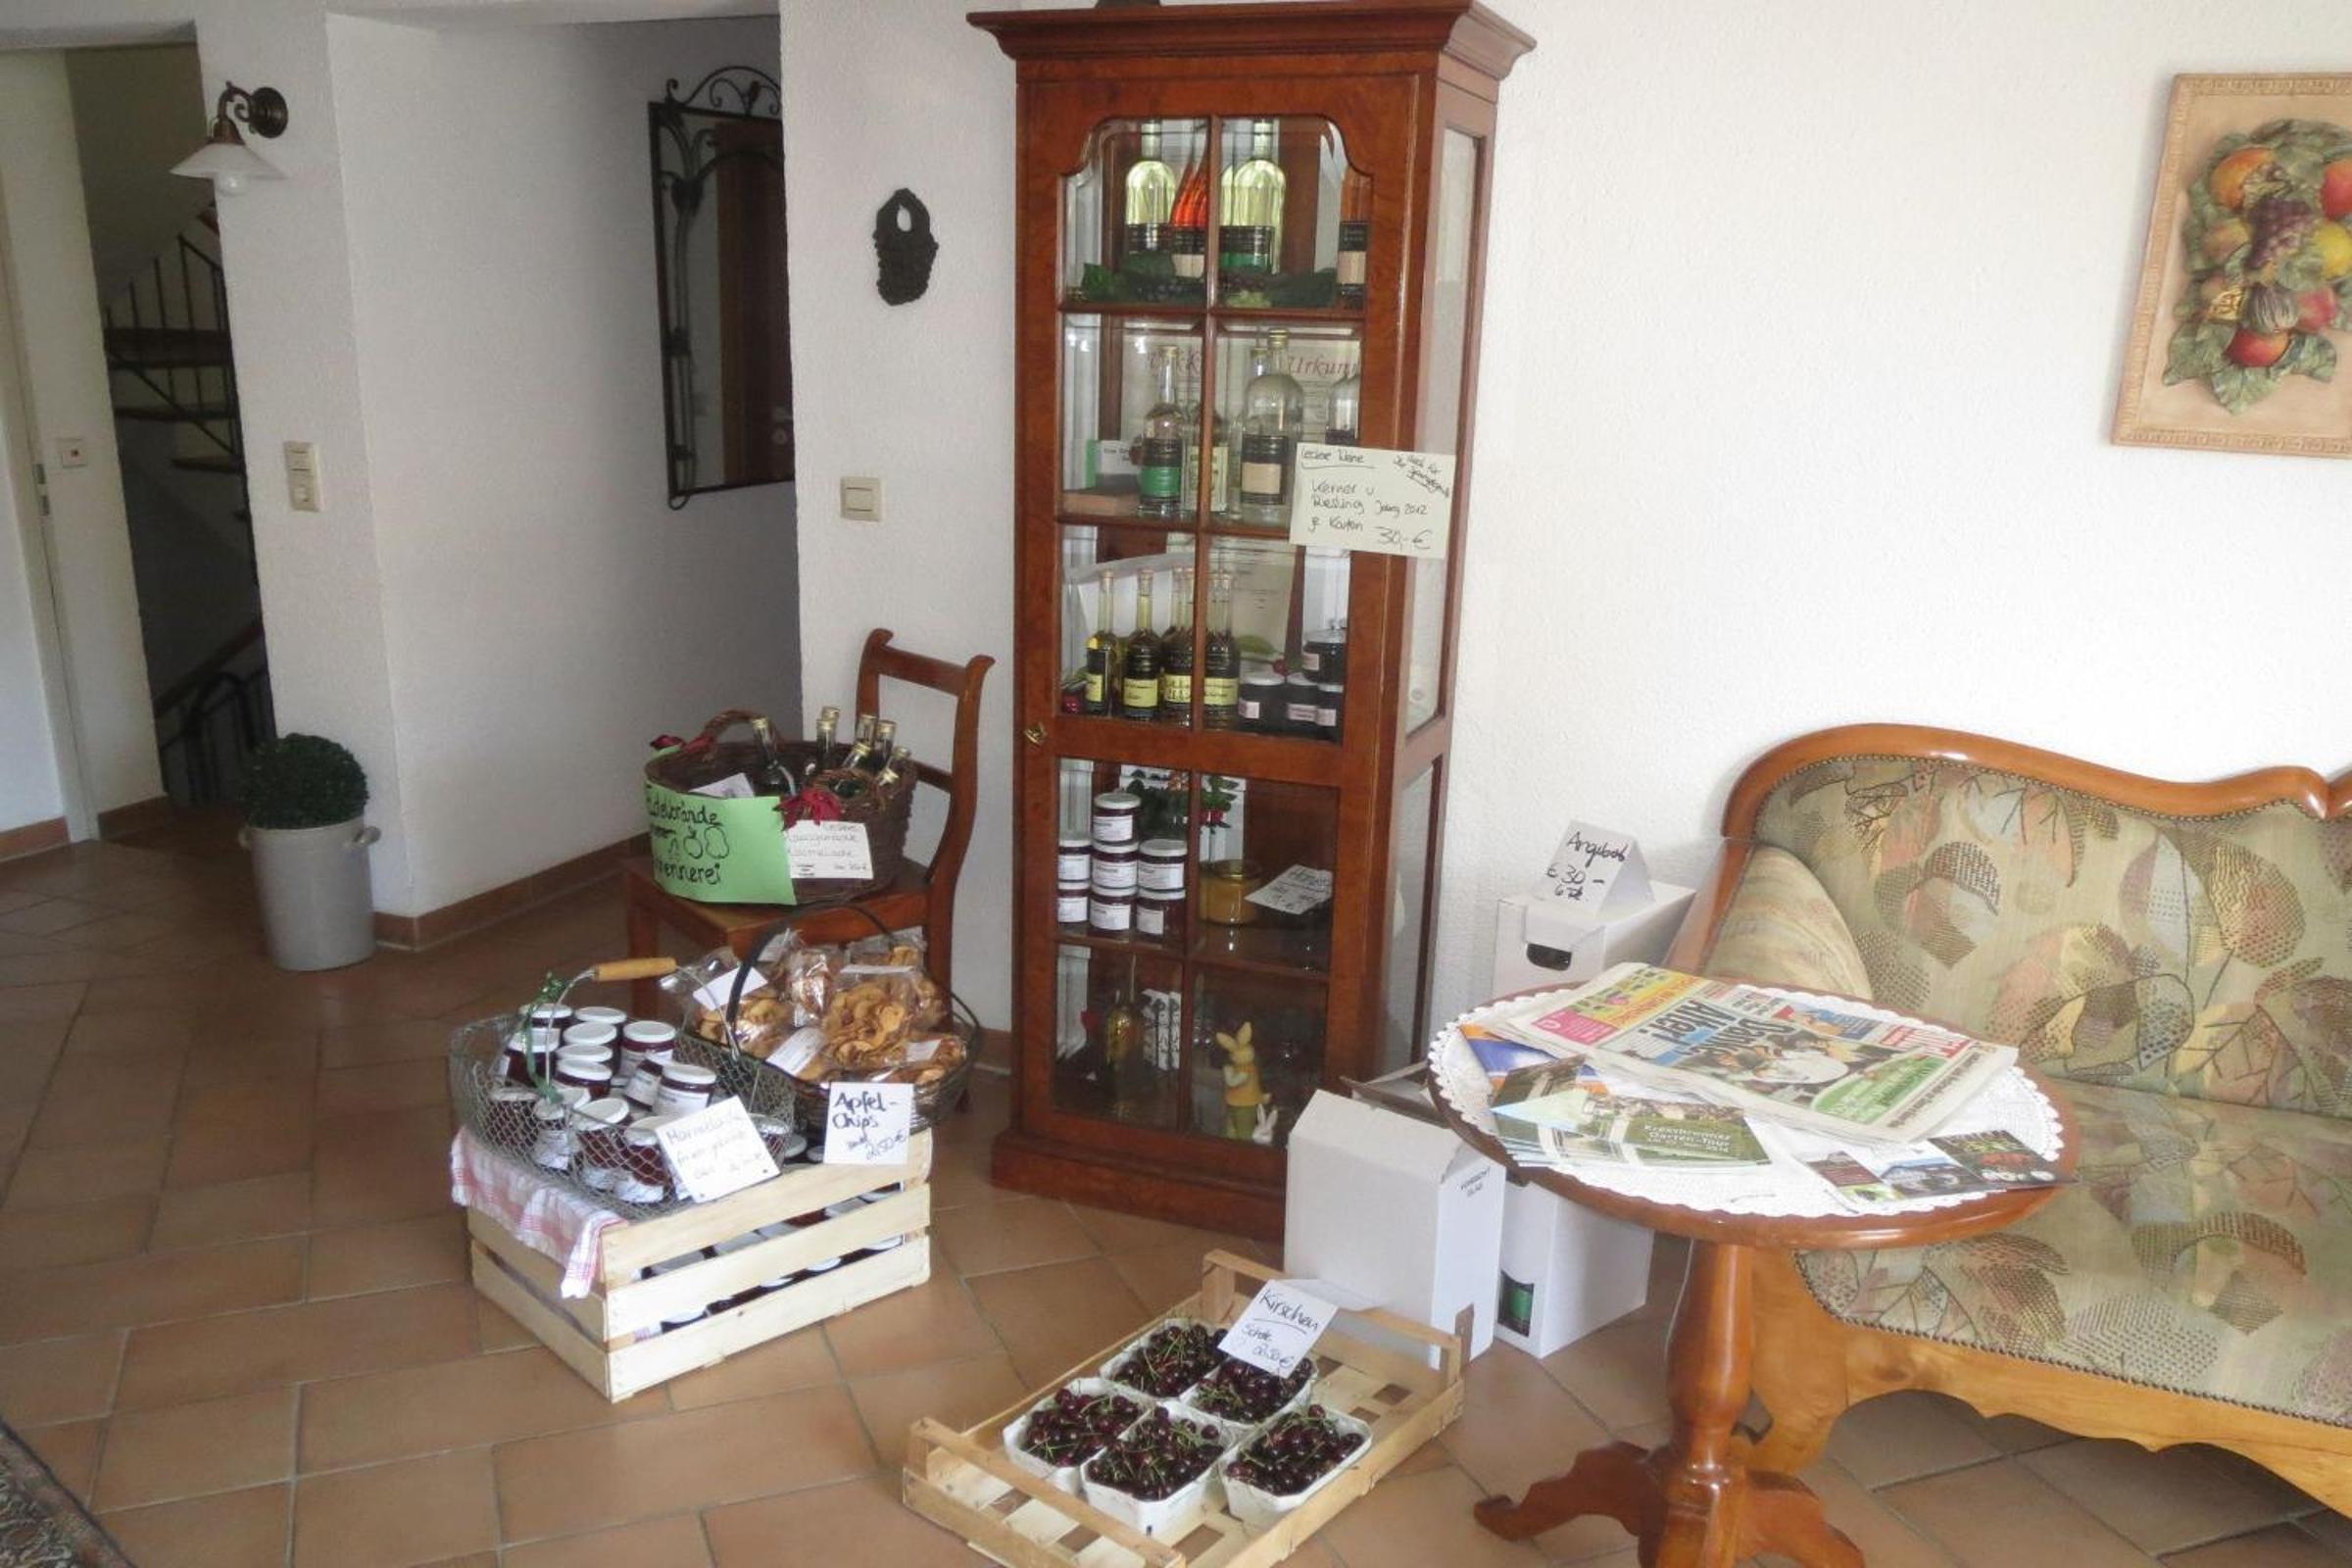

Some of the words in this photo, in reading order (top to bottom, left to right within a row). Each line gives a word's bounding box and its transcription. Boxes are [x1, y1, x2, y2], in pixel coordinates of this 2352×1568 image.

[1289, 353, 1359, 376] Urkun
[1566, 831, 1628, 868] Angebot
[1259, 1287, 1319, 1334] Kirschen
